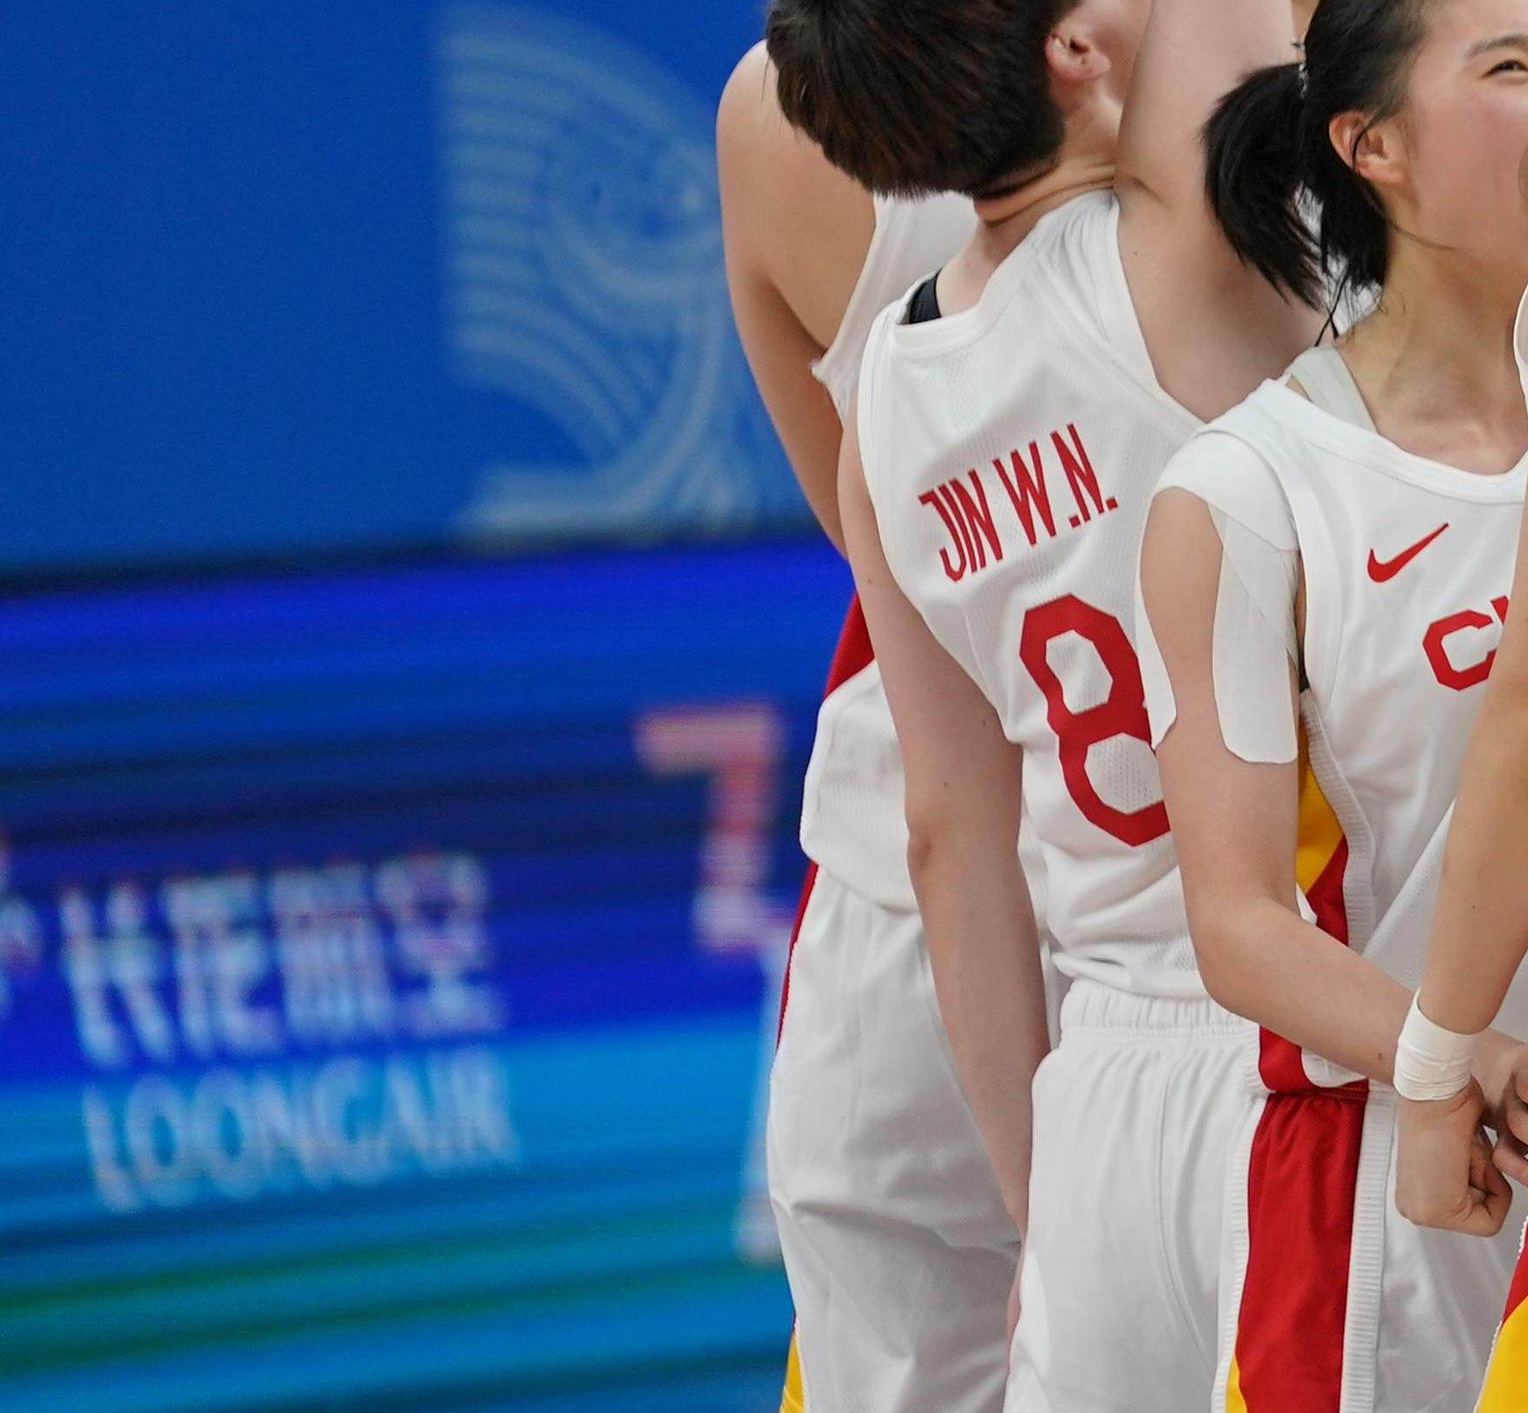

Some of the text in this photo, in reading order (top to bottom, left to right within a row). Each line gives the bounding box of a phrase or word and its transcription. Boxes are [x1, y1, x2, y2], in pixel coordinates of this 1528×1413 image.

[918, 423, 1119, 583] JIN W.N.
[1018, 592, 1172, 849] 8
[80, 1045, 524, 1214] LOONGAIR
